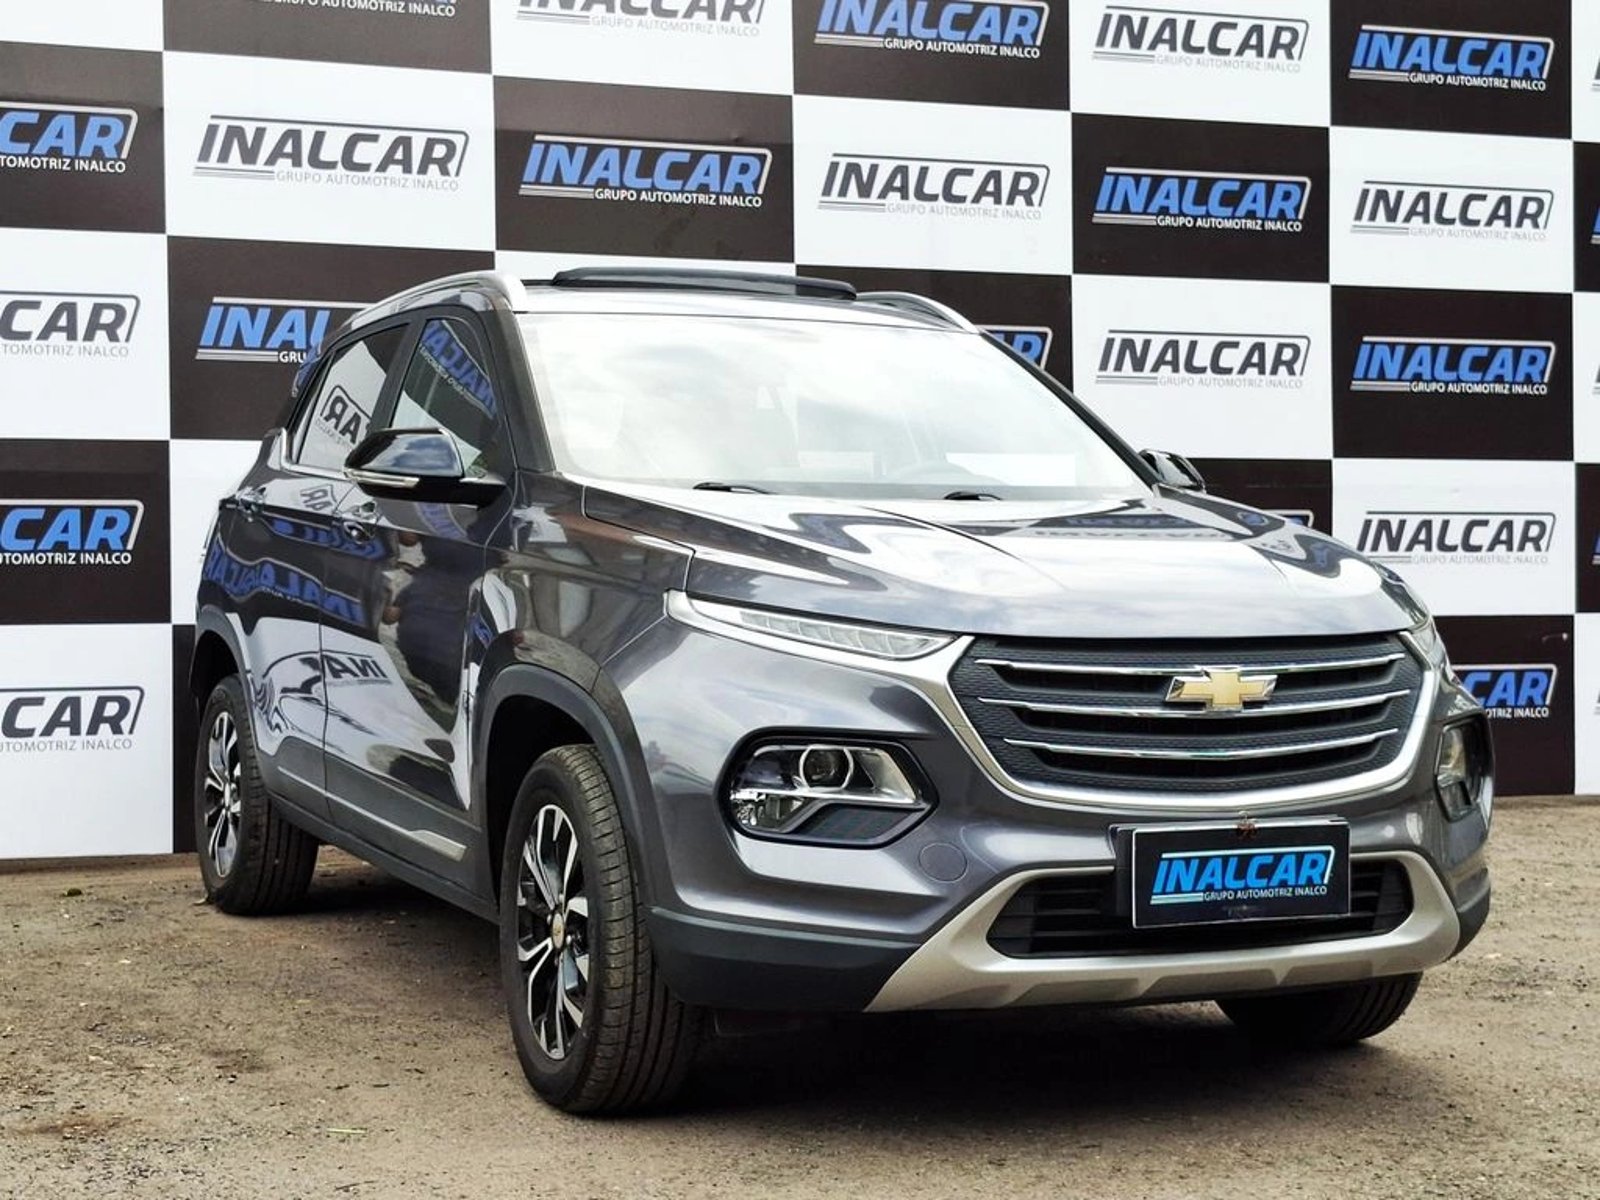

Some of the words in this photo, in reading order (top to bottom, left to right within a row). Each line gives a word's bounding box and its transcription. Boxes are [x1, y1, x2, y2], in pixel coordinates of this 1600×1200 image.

[409, 4, 455, 16] INALCO
[817, 0, 1039, 45] INALCAR
[884, 38, 924, 50] GRUPO
[926, 40, 997, 56] AUTOMOTRIZ
[1000, 46, 1040, 58] INALCO
[1096, 14, 1300, 60] INALCAR
[1352, 32, 1545, 78] INALCAR
[1410, 72, 1444, 84] GRUPO
[1446, 75, 1508, 88] AUTOMOTRIZ
[1511, 79, 1546, 91] INALCO
[0, 111, 124, 158] CAR
[197, 124, 457, 176] INALCAR
[75, 160, 126, 172] INALCO
[276, 170, 321, 183] GRUPO
[326, 173, 410, 188] AUTOMOTRIZ
[413, 178, 458, 191] INALCO
[522, 144, 761, 194] INALCAR
[821, 162, 1040, 207] INALCAR
[595, 188, 637, 200] GRUPO
[640, 191, 716, 206] AUTOMOTRIZ
[719, 194, 762, 207] INALCO
[1096, 174, 1301, 220] INALCAR
[1353, 188, 1545, 229] INALCAR
[1158, 216, 1194, 227] GRUPO
[1196, 217, 1262, 230] AUTOMOTRIZ
[1264, 221, 1302, 232] INALCO
[0, 300, 127, 342] CAR
[79, 346, 128, 357] INALCO
[1098, 338, 1301, 376] INALCAR
[1353, 344, 1547, 383] INALCAR
[1410, 382, 1445, 392] GRUPO
[1447, 382, 1510, 394] AUTOMOTRIZ
[1512, 384, 1547, 394] INALCO
[0, 508, 130, 551] CAR
[1356, 519, 1547, 552] INALCAR
[81, 552, 132, 565] INALCO
[1463, 671, 1548, 707] CAR
[2, 696, 130, 738] CAR
[1514, 708, 1548, 718] INALCO
[82, 739, 132, 750] INALCO
[1152, 852, 1326, 893] INALCAR
[1204, 890, 1234, 901] GRUPO
[1236, 886, 1292, 899] AUTOMOTRIZ
[1295, 886, 1328, 896] INALCO
